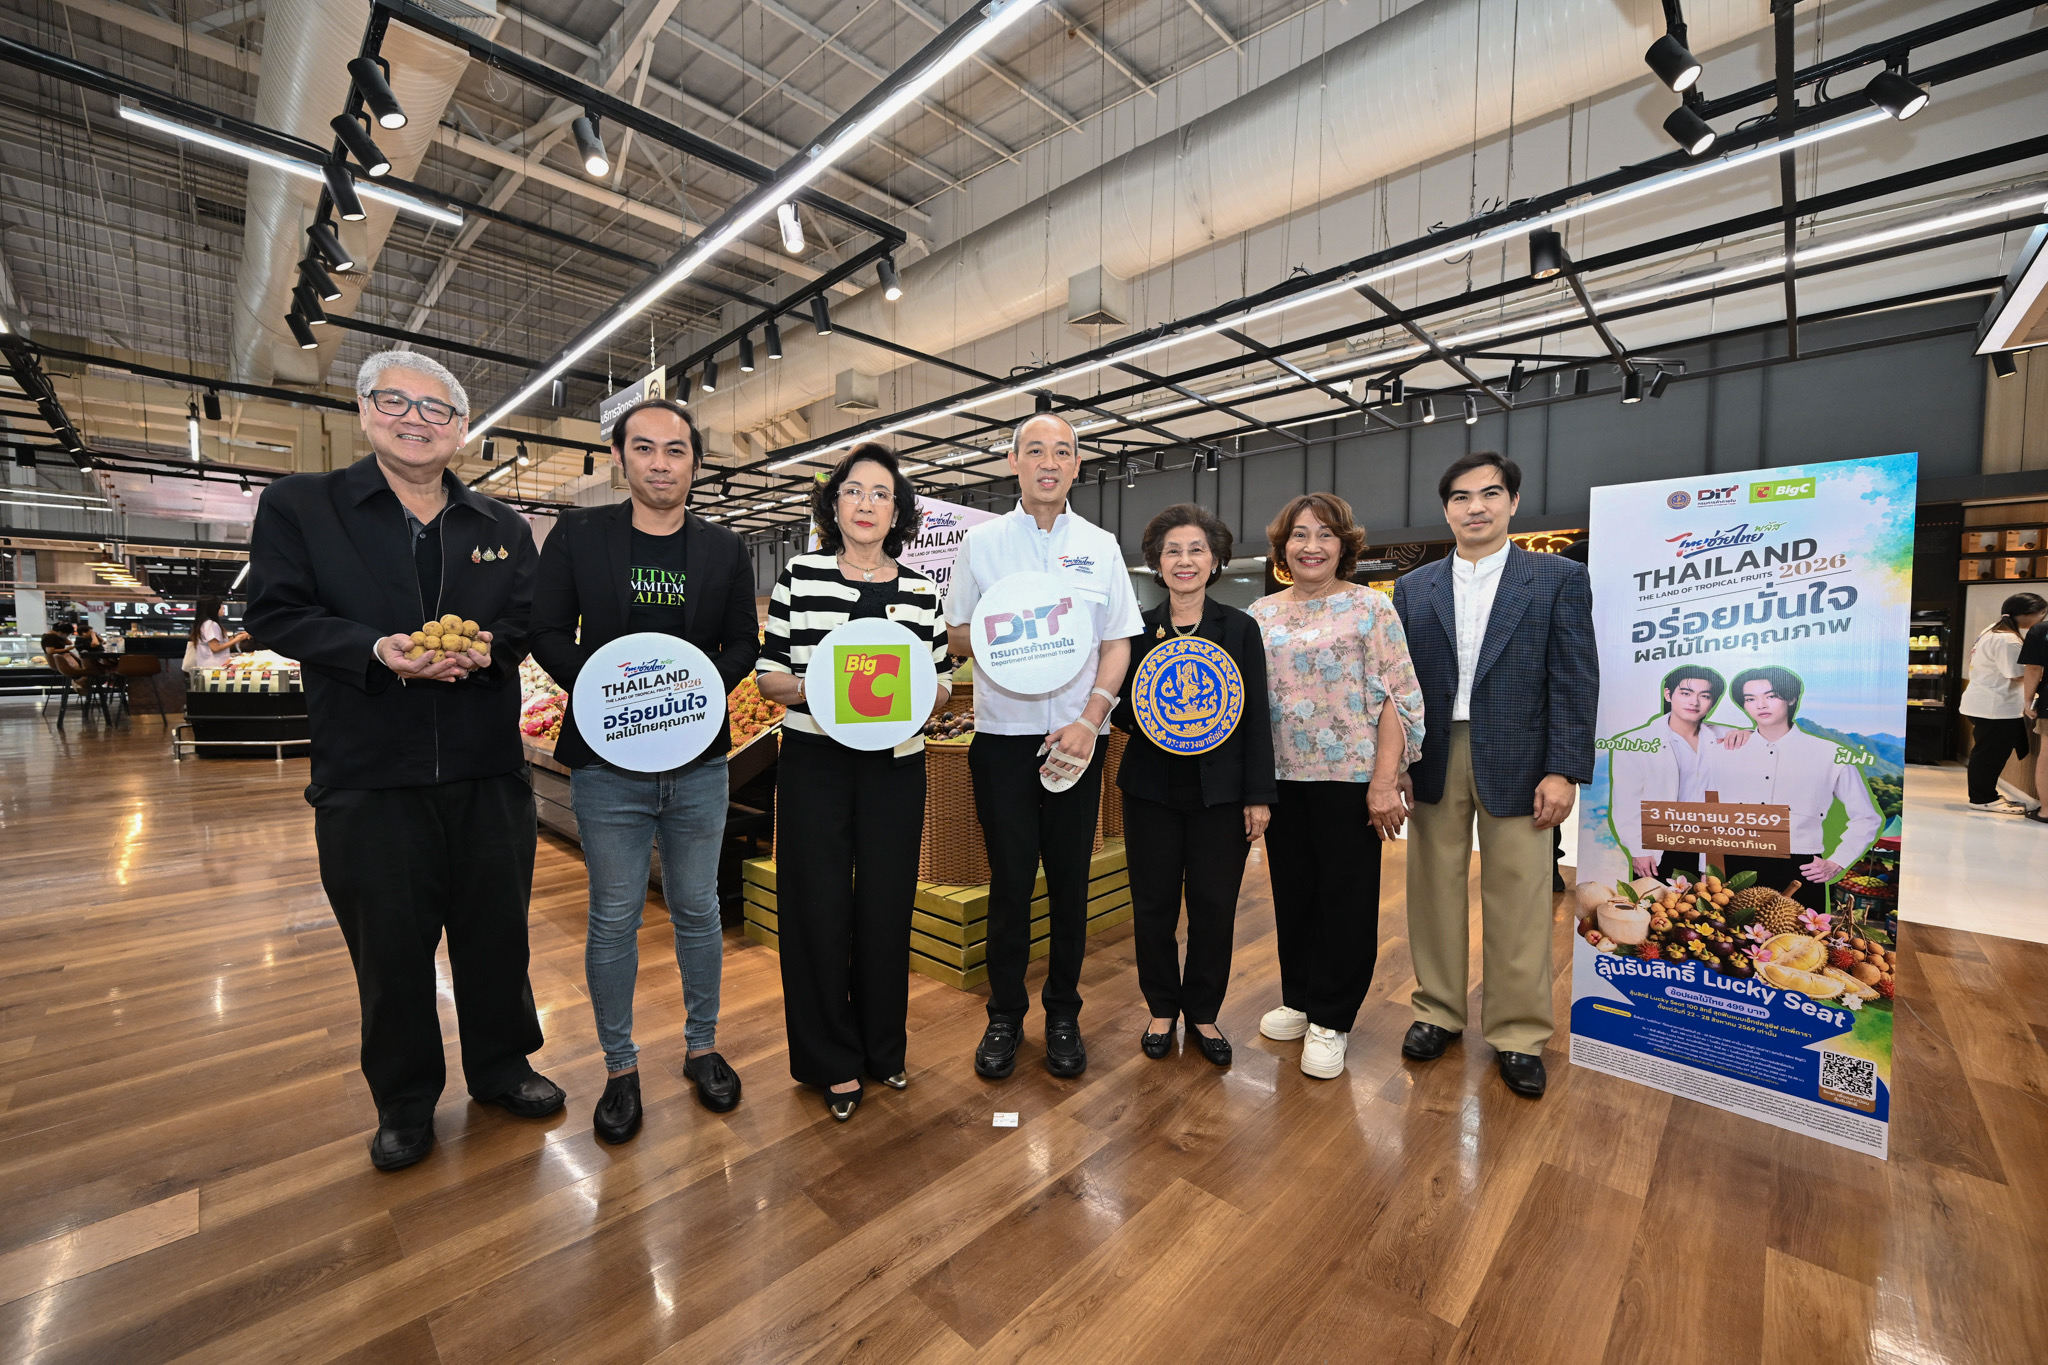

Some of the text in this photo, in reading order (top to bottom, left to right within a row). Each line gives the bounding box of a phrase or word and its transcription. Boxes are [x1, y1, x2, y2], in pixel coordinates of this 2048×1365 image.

[1775, 483, 1810, 496] BigC
[1633, 538, 1818, 592] THAILAND
[1779, 553, 1847, 579] 2026
[1656, 589, 1679, 599] LAND
[1681, 586, 1692, 594] OF
[1695, 578, 1738, 591] TROPICAL
[1740, 571, 1773, 582] FRUITS
[1632, 581, 1858, 643] อร่อยมั่นใจ
[990, 637, 1074, 660] กรมการค้าภายใน
[1634, 617, 1852, 663] ผลไม้ไทยคุณภาพ
[846, 654, 878, 675] Big
[991, 656, 1027, 667] Department
[1034, 652, 1056, 660] Internal
[1057, 648, 1076, 656] Trade
[602, 669, 690, 697] THAILAND
[635, 690, 655, 698] TROPICAL
[673, 678, 702, 691] 2026
[603, 692, 707, 730] อร่อยมั่นใจ
[606, 711, 706, 742] ผลไม้ไทยคุณภาพ
[1596, 738, 1660, 753] คอปเปอร์
[1650, 808, 1781, 826] 3 กันยายน 2569
[1669, 823, 1700, 833] 17.00
[1712, 826, 1745, 837] 19.00
[1748, 829, 1761, 838] น.
[1656, 834, 1777, 851] BigC สาขารัชดาภิเษก
[1598, 957, 1846, 1028] ลุ้นรับสิทธิ์ Lucky Seat
[1650, 995, 1669, 1004] Lucky
[1686, 1003, 1699, 1011] 100
[1670, 988, 1766, 1017] ช้อปผลไม้ไทย 499 บาท
[1711, 1016, 1737, 1028] สิงหาคม
[1738, 1022, 1756, 1032] 2569
